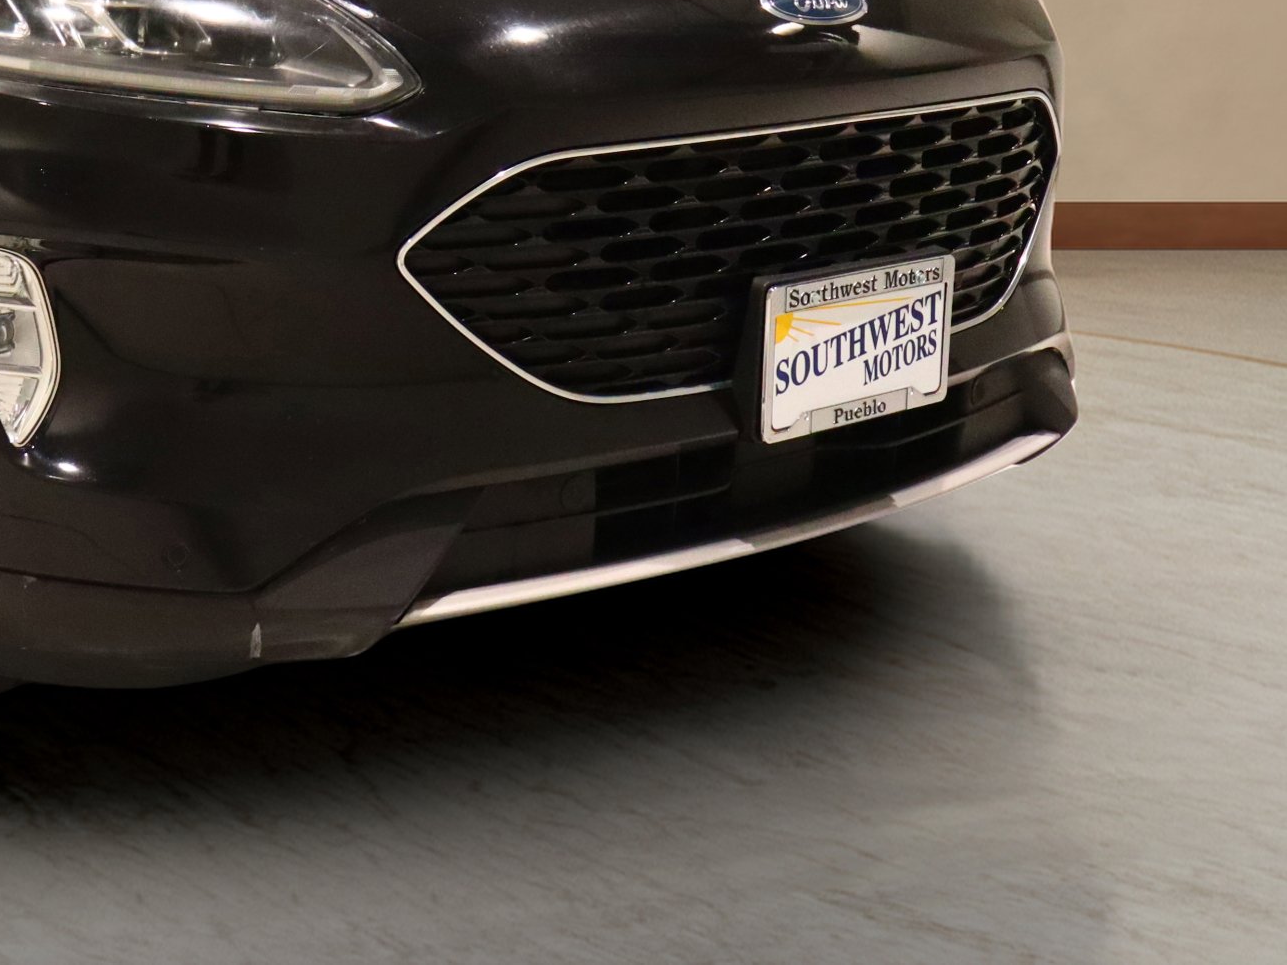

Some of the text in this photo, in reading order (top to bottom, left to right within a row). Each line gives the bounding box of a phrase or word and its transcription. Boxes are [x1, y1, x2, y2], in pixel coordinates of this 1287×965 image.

[775, 290, 943, 397] SOUTHWEST
[863, 329, 938, 386] MOTORS
[833, 399, 887, 425] Pueblo
